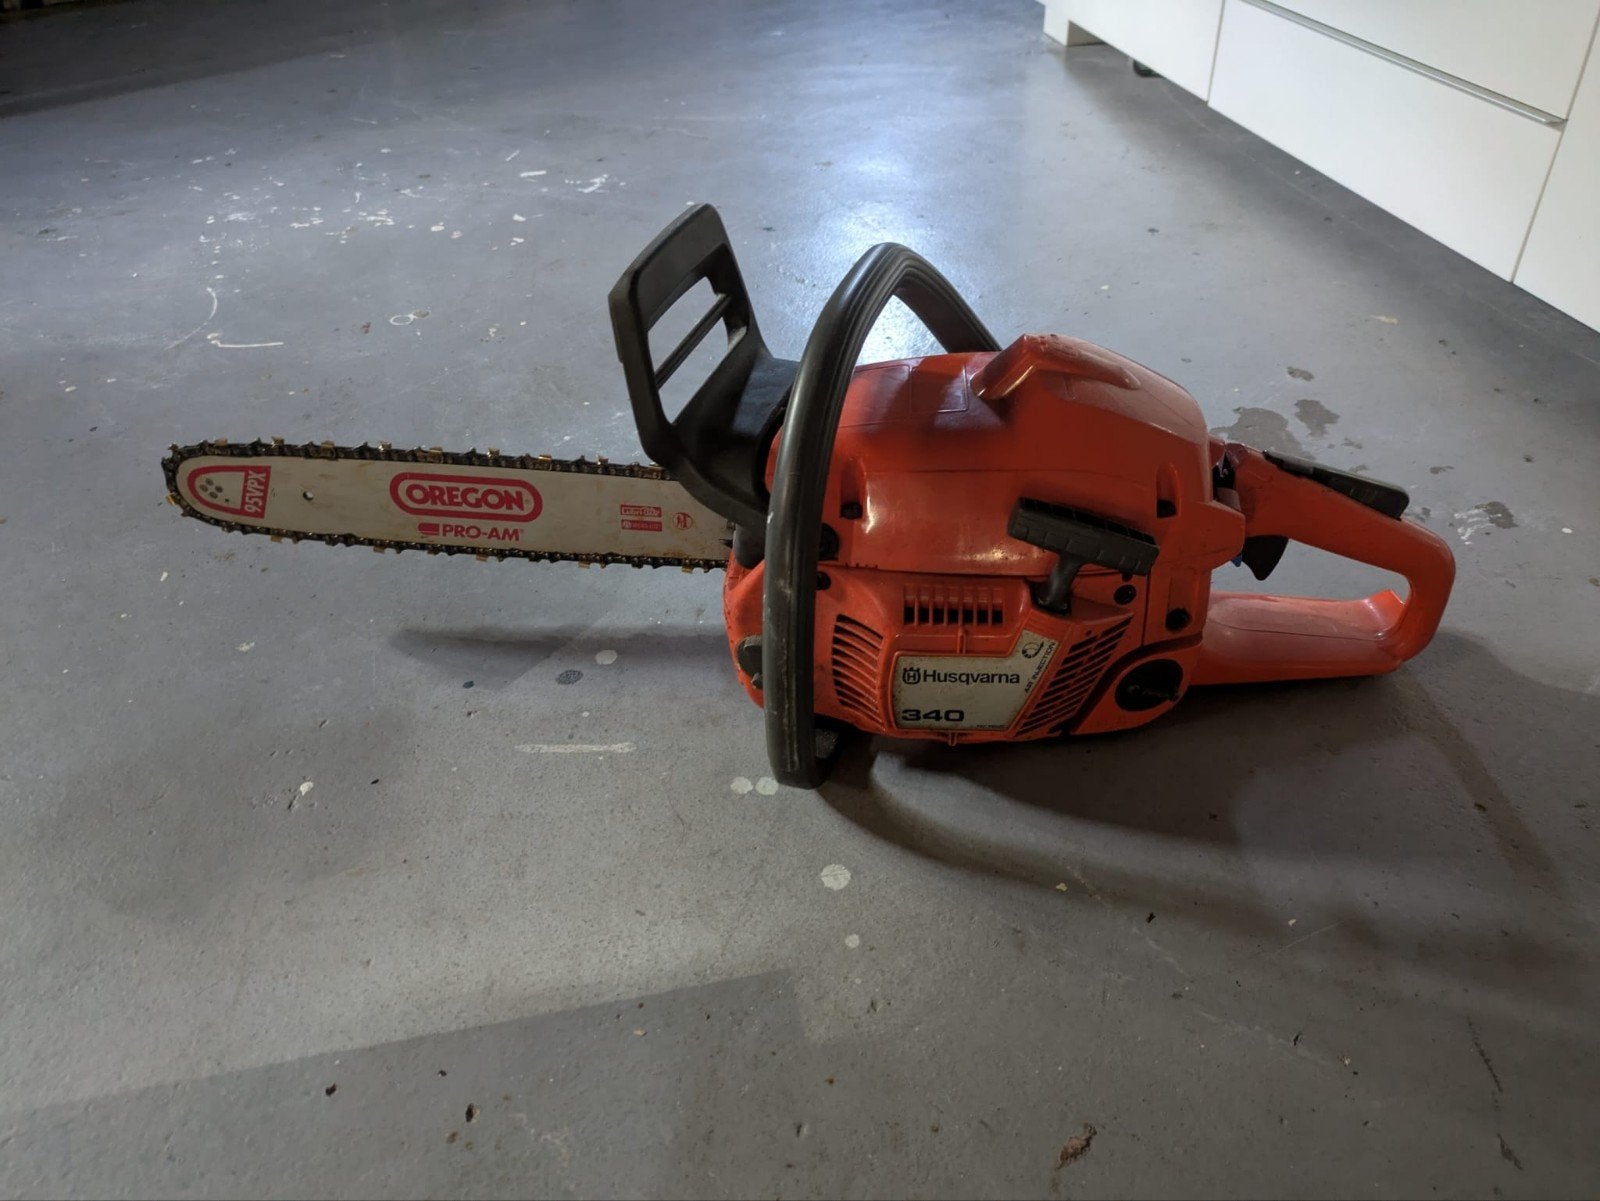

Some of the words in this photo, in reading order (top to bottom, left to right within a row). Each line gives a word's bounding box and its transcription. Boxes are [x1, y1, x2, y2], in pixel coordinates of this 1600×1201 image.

[244, 470, 267, 513] 95VPX
[406, 484, 525, 512] OREGON
[442, 523, 520, 542] PRO-AM
[1032, 640, 1057, 680] INJECTION
[922, 669, 1021, 685] Husqvarna
[901, 709, 965, 722] 340
